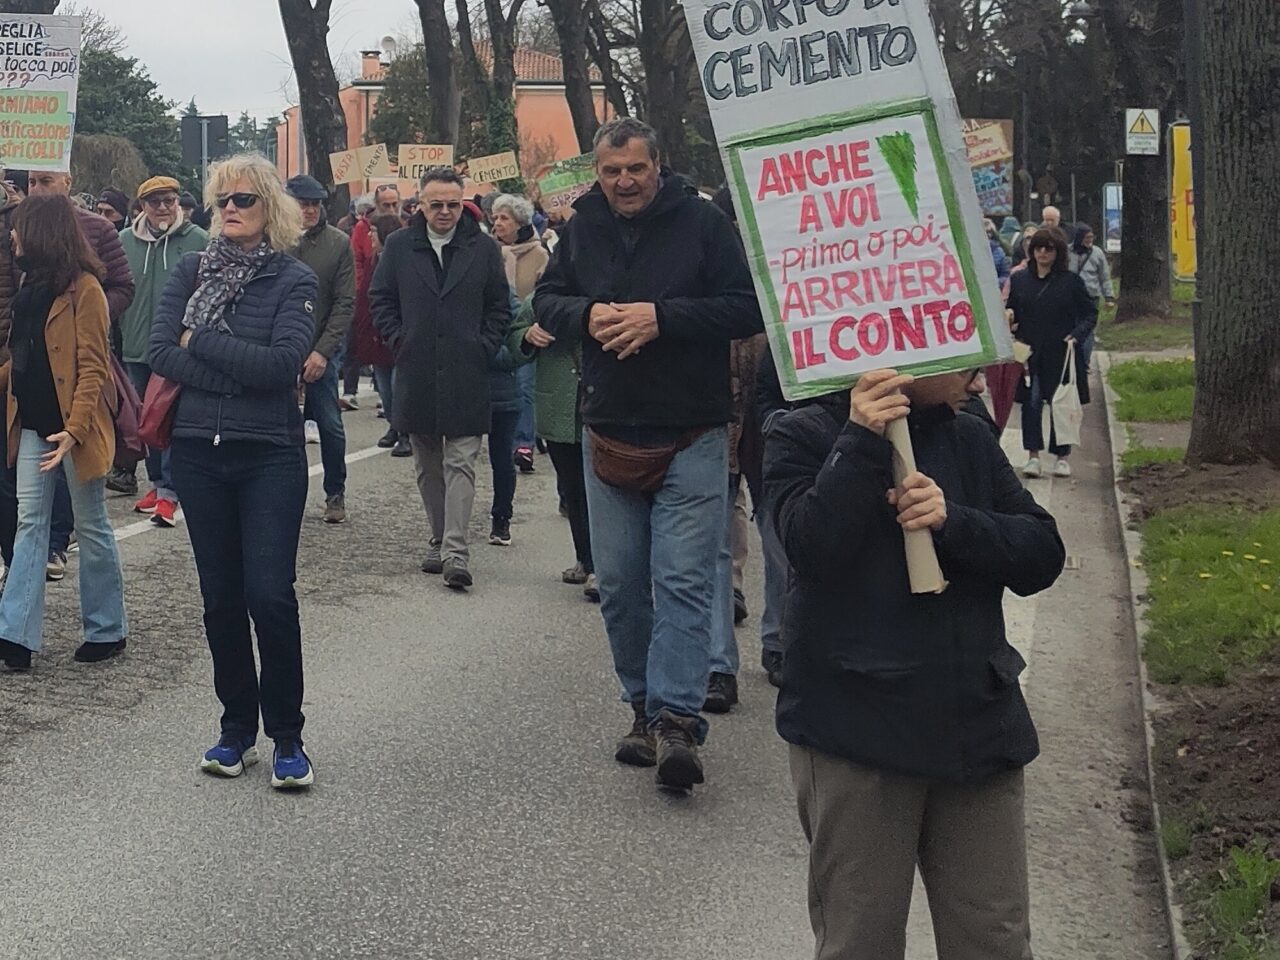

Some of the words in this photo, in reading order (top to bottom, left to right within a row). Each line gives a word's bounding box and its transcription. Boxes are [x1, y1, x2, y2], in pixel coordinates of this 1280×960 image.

[5, 57, 48, 71] tocca
[51, 58, 75, 76] poi
[703, 23, 917, 101] CEMENTO
[26, 141, 64, 159] COLLI
[363, 145, 384, 178] CEMENTO
[408, 147, 444, 160] STOP
[476, 154, 508, 168] STOP
[335, 153, 354, 180] BASTA
[399, 165, 408, 179] AL
[473, 166, 516, 183] CEMENTO
[757, 139, 874, 201] ANCHE
[799, 194, 824, 234] A
[823, 183, 882, 229] VOI
[780, 242, 967, 323] ARRIVERÀ
[792, 326, 826, 370] IL
[828, 299, 977, 361] CONTO
